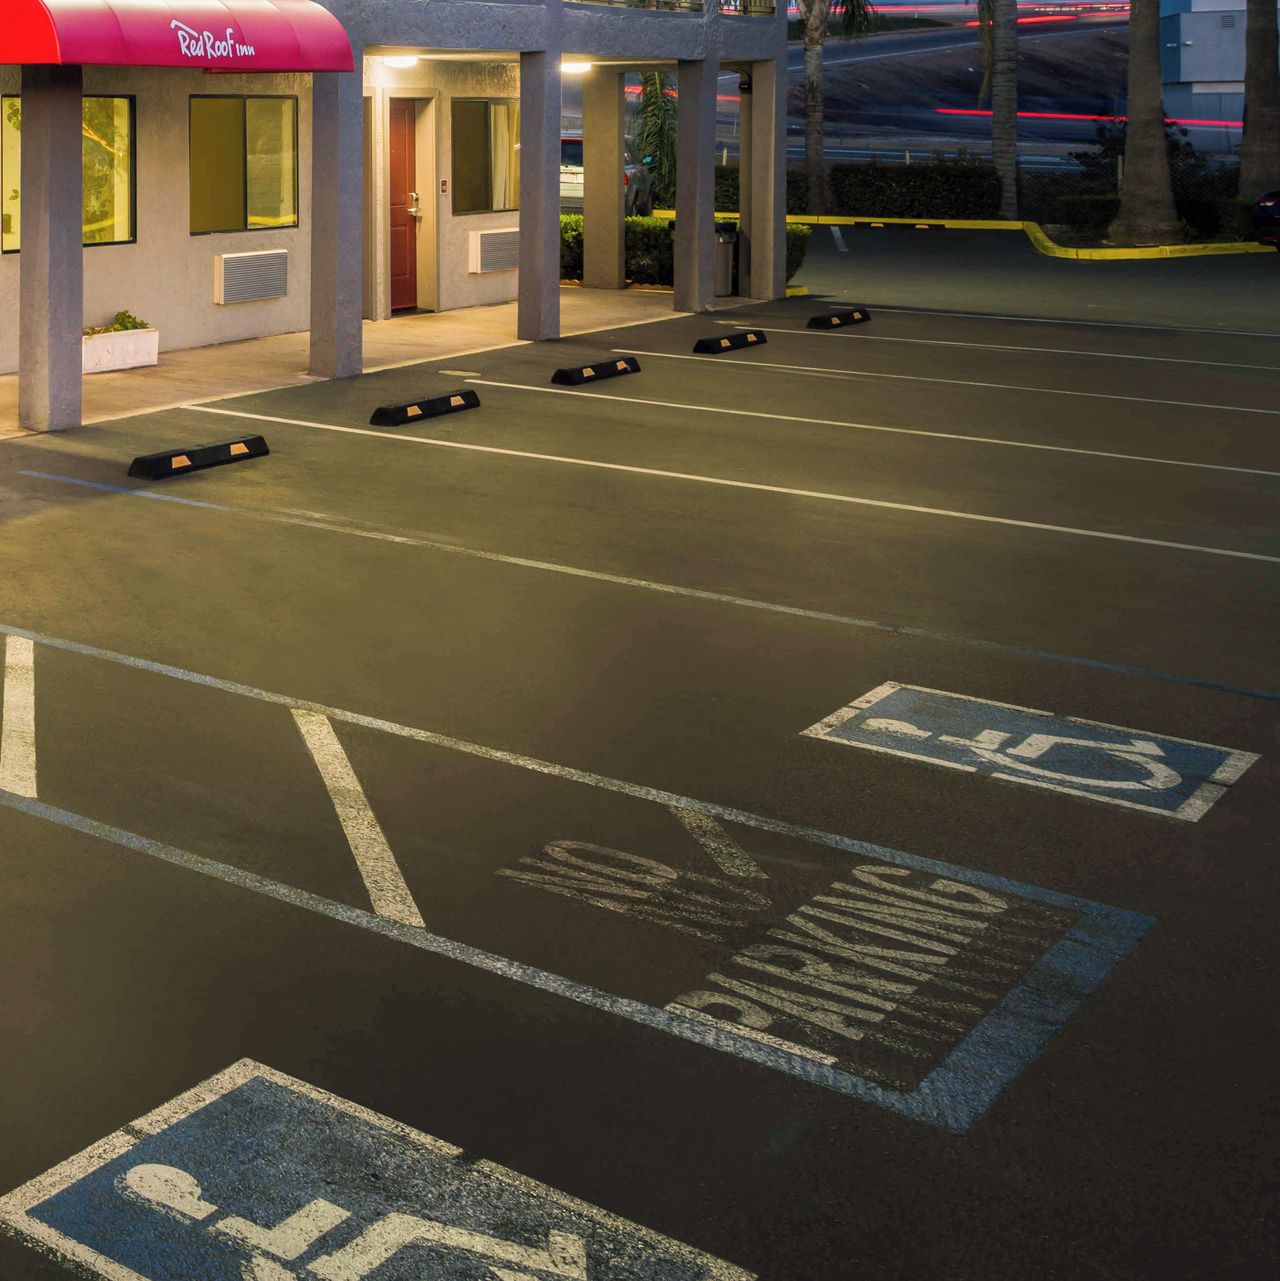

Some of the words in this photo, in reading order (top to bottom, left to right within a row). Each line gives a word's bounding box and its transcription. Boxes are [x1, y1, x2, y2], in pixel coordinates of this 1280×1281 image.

[177, 30, 205, 58] Red
[203, 27, 235, 60] Roof
[663, 864, 1010, 1076] PARKING
